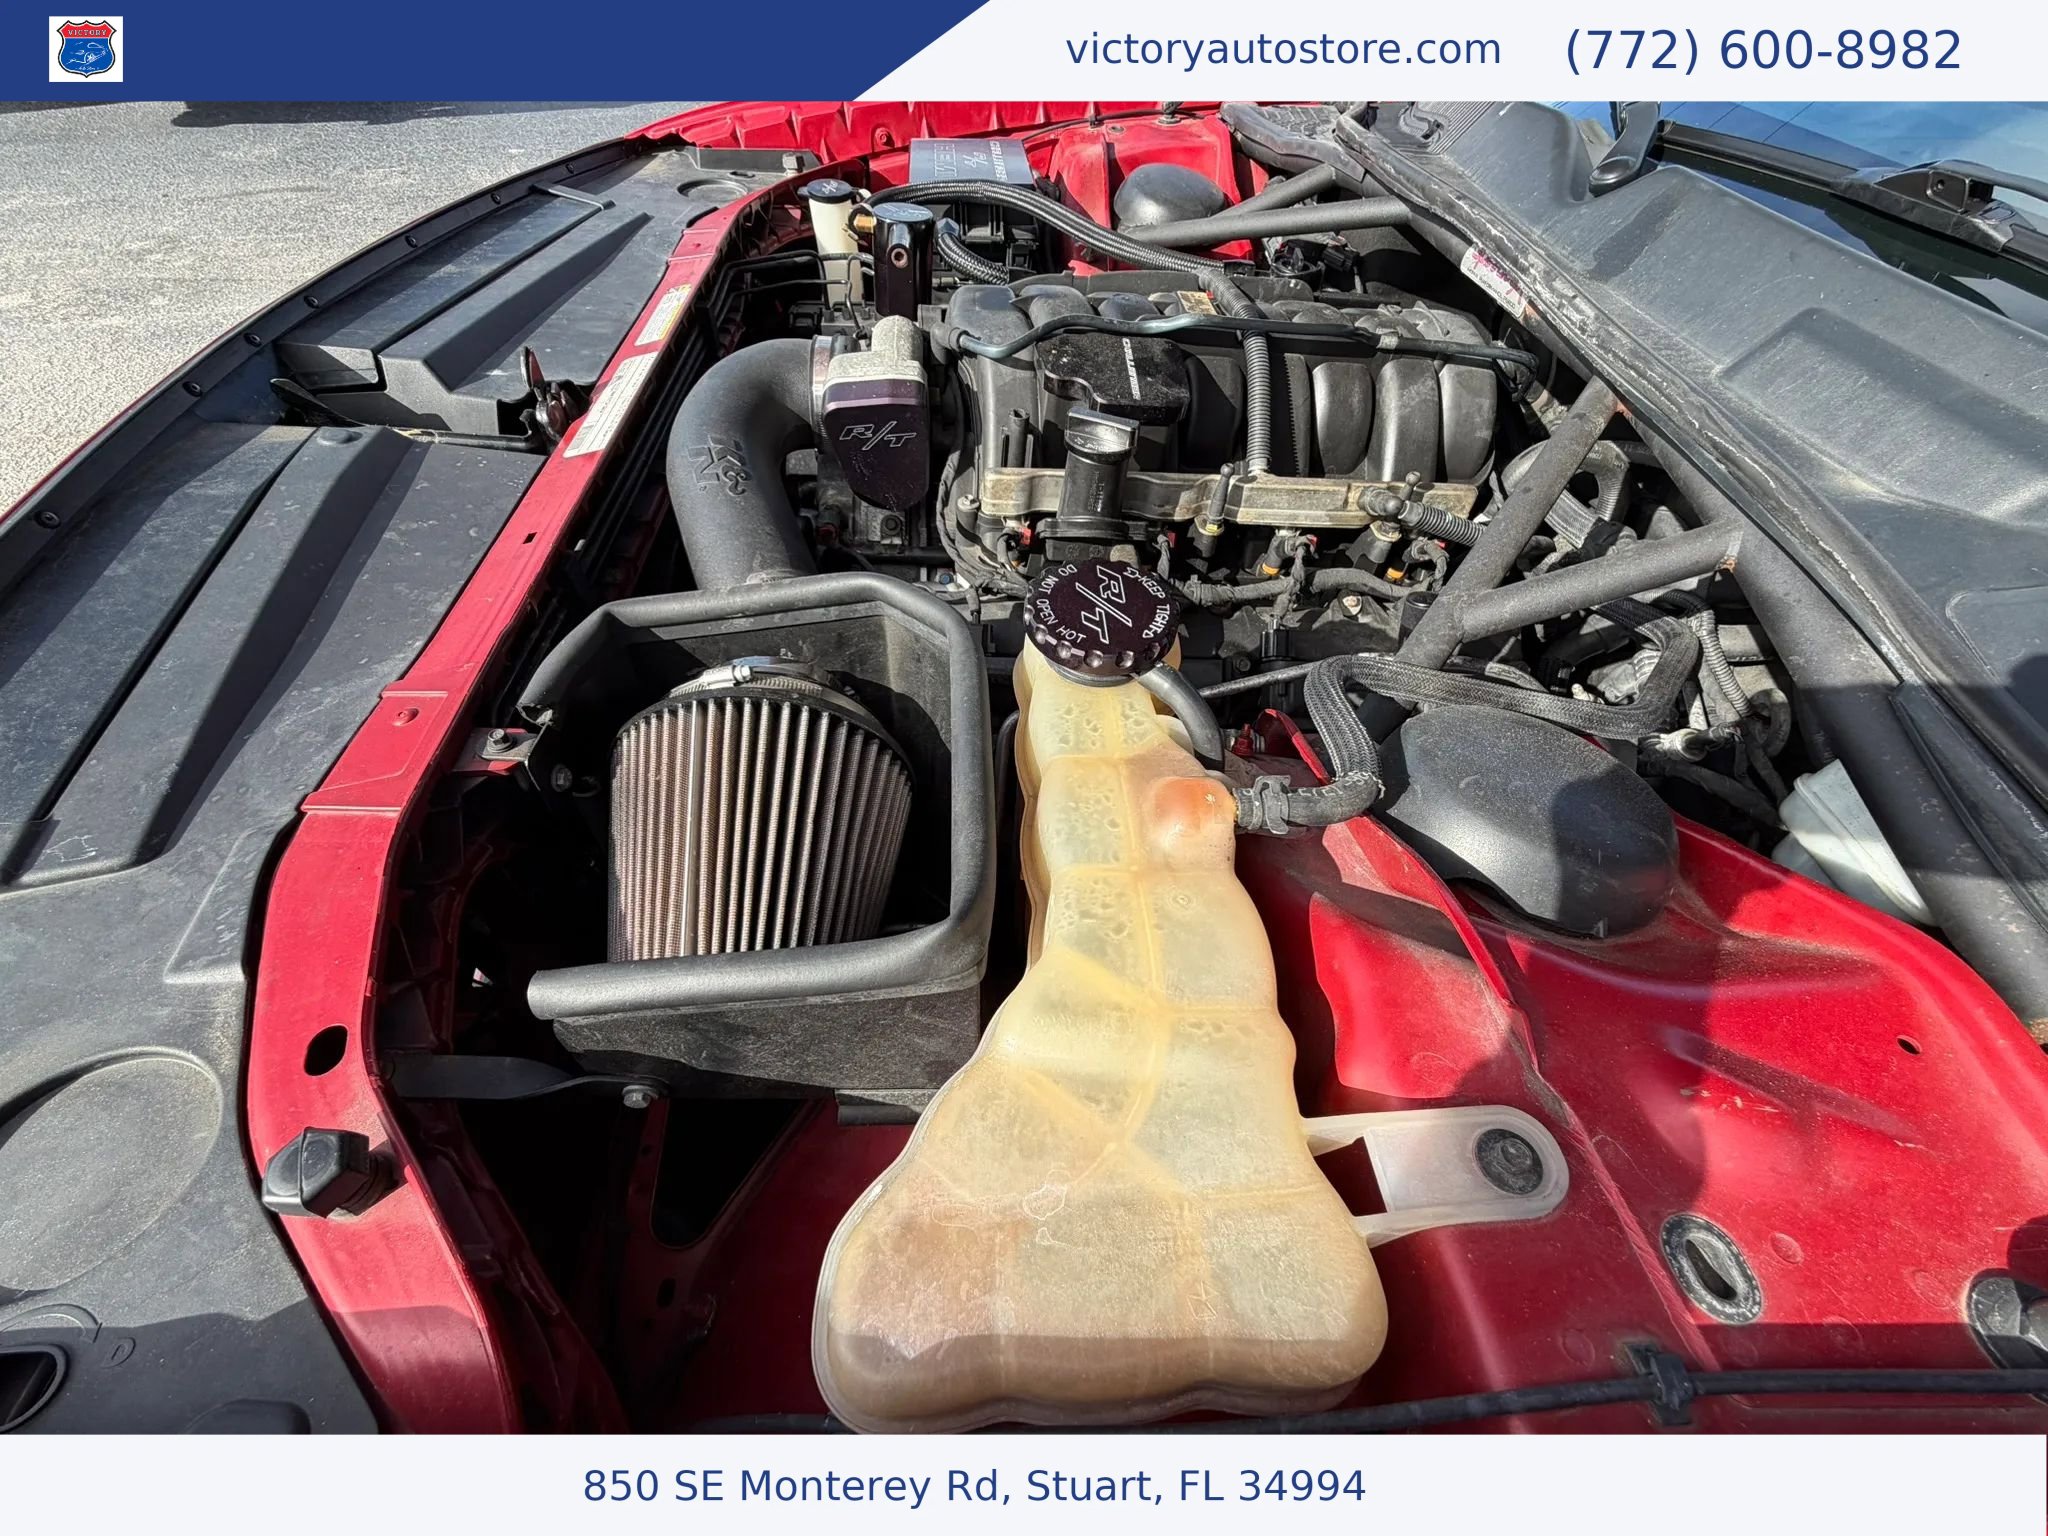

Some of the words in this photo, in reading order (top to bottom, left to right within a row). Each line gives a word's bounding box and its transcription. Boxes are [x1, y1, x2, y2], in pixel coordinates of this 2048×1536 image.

[839, 420, 917, 451] R/T
[1057, 563, 1078, 577] DO
[1038, 574, 1059, 595] NOT
[1035, 598, 1059, 625] OPEN
[1075, 565, 1133, 645] R/T
[1138, 575, 1166, 600] KEEP
[1152, 603, 1171, 635] TIGHT
[1055, 625, 1087, 644] HOT
